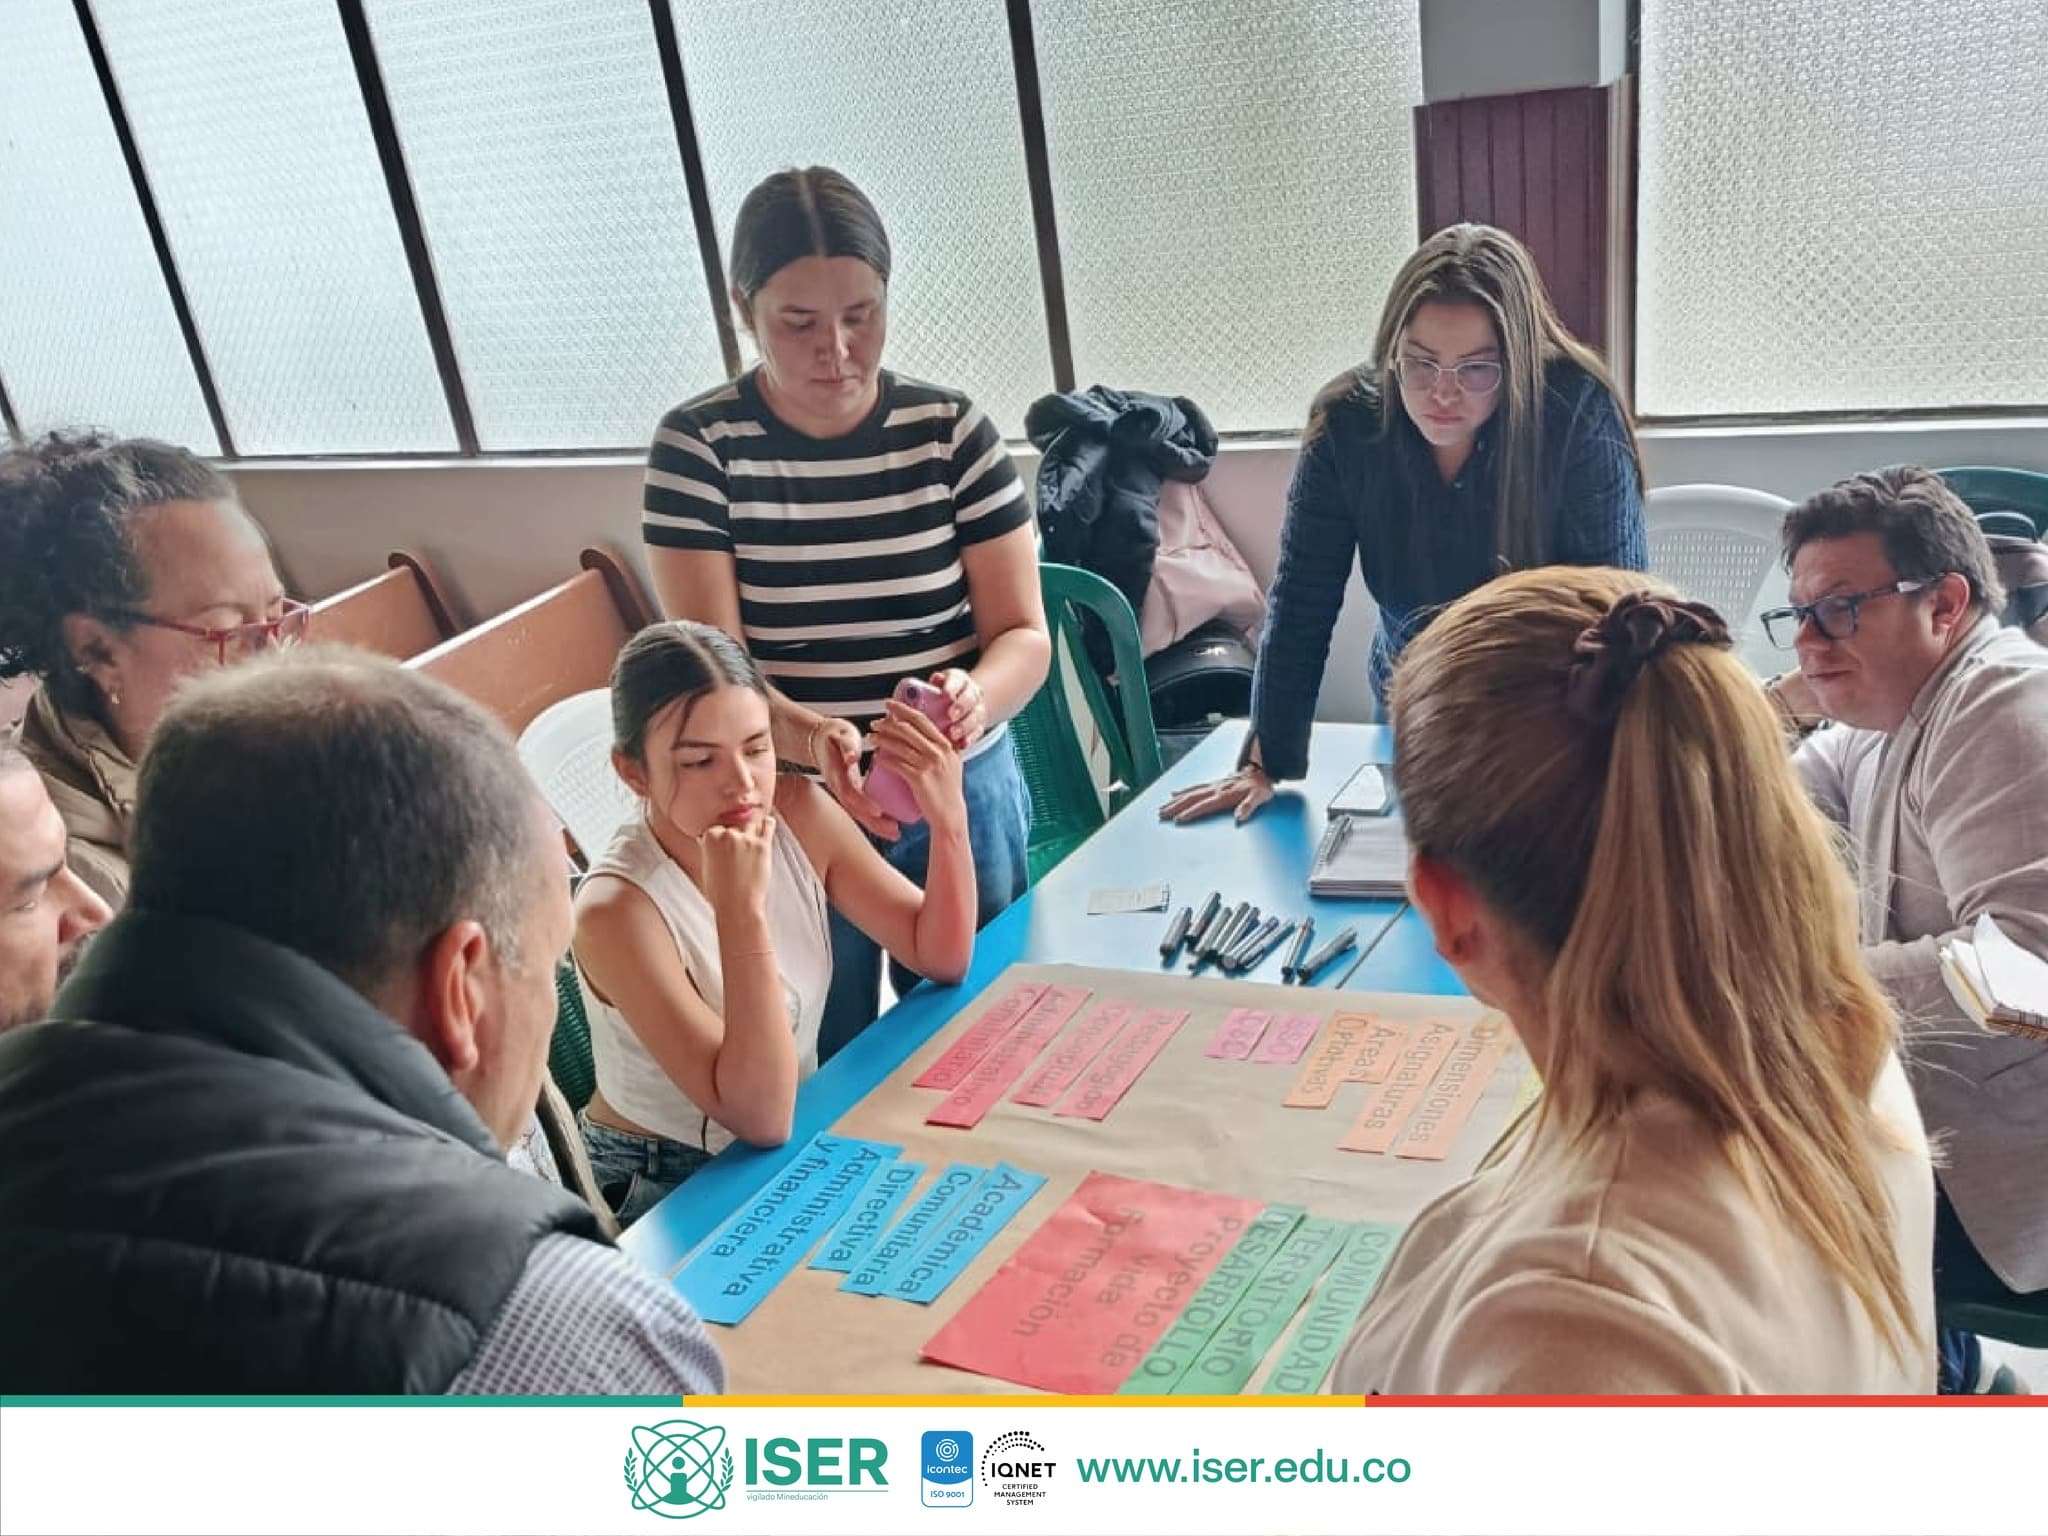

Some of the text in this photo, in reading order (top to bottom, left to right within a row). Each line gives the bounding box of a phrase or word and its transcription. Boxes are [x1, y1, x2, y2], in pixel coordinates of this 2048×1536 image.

[1365, 1023, 1454, 1129] Asignaturas
[1408, 1026, 1497, 1142] Dimensiones
[711, 1154, 829, 1258] financiera
[722, 1146, 881, 1297] Administrativa
[827, 1167, 915, 1263] Directiva
[851, 1171, 972, 1286] Comunitaria
[900, 1173, 1023, 1295] Académica
[1096, 1254, 1157, 1306] vida
[1101, 1216, 1241, 1368] Proyecto de
[1143, 1209, 1299, 1378] DESARROLLO
[1200, 1225, 1336, 1377] TERRITORIO
[1274, 1231, 1390, 1393] COMUNIDAD
